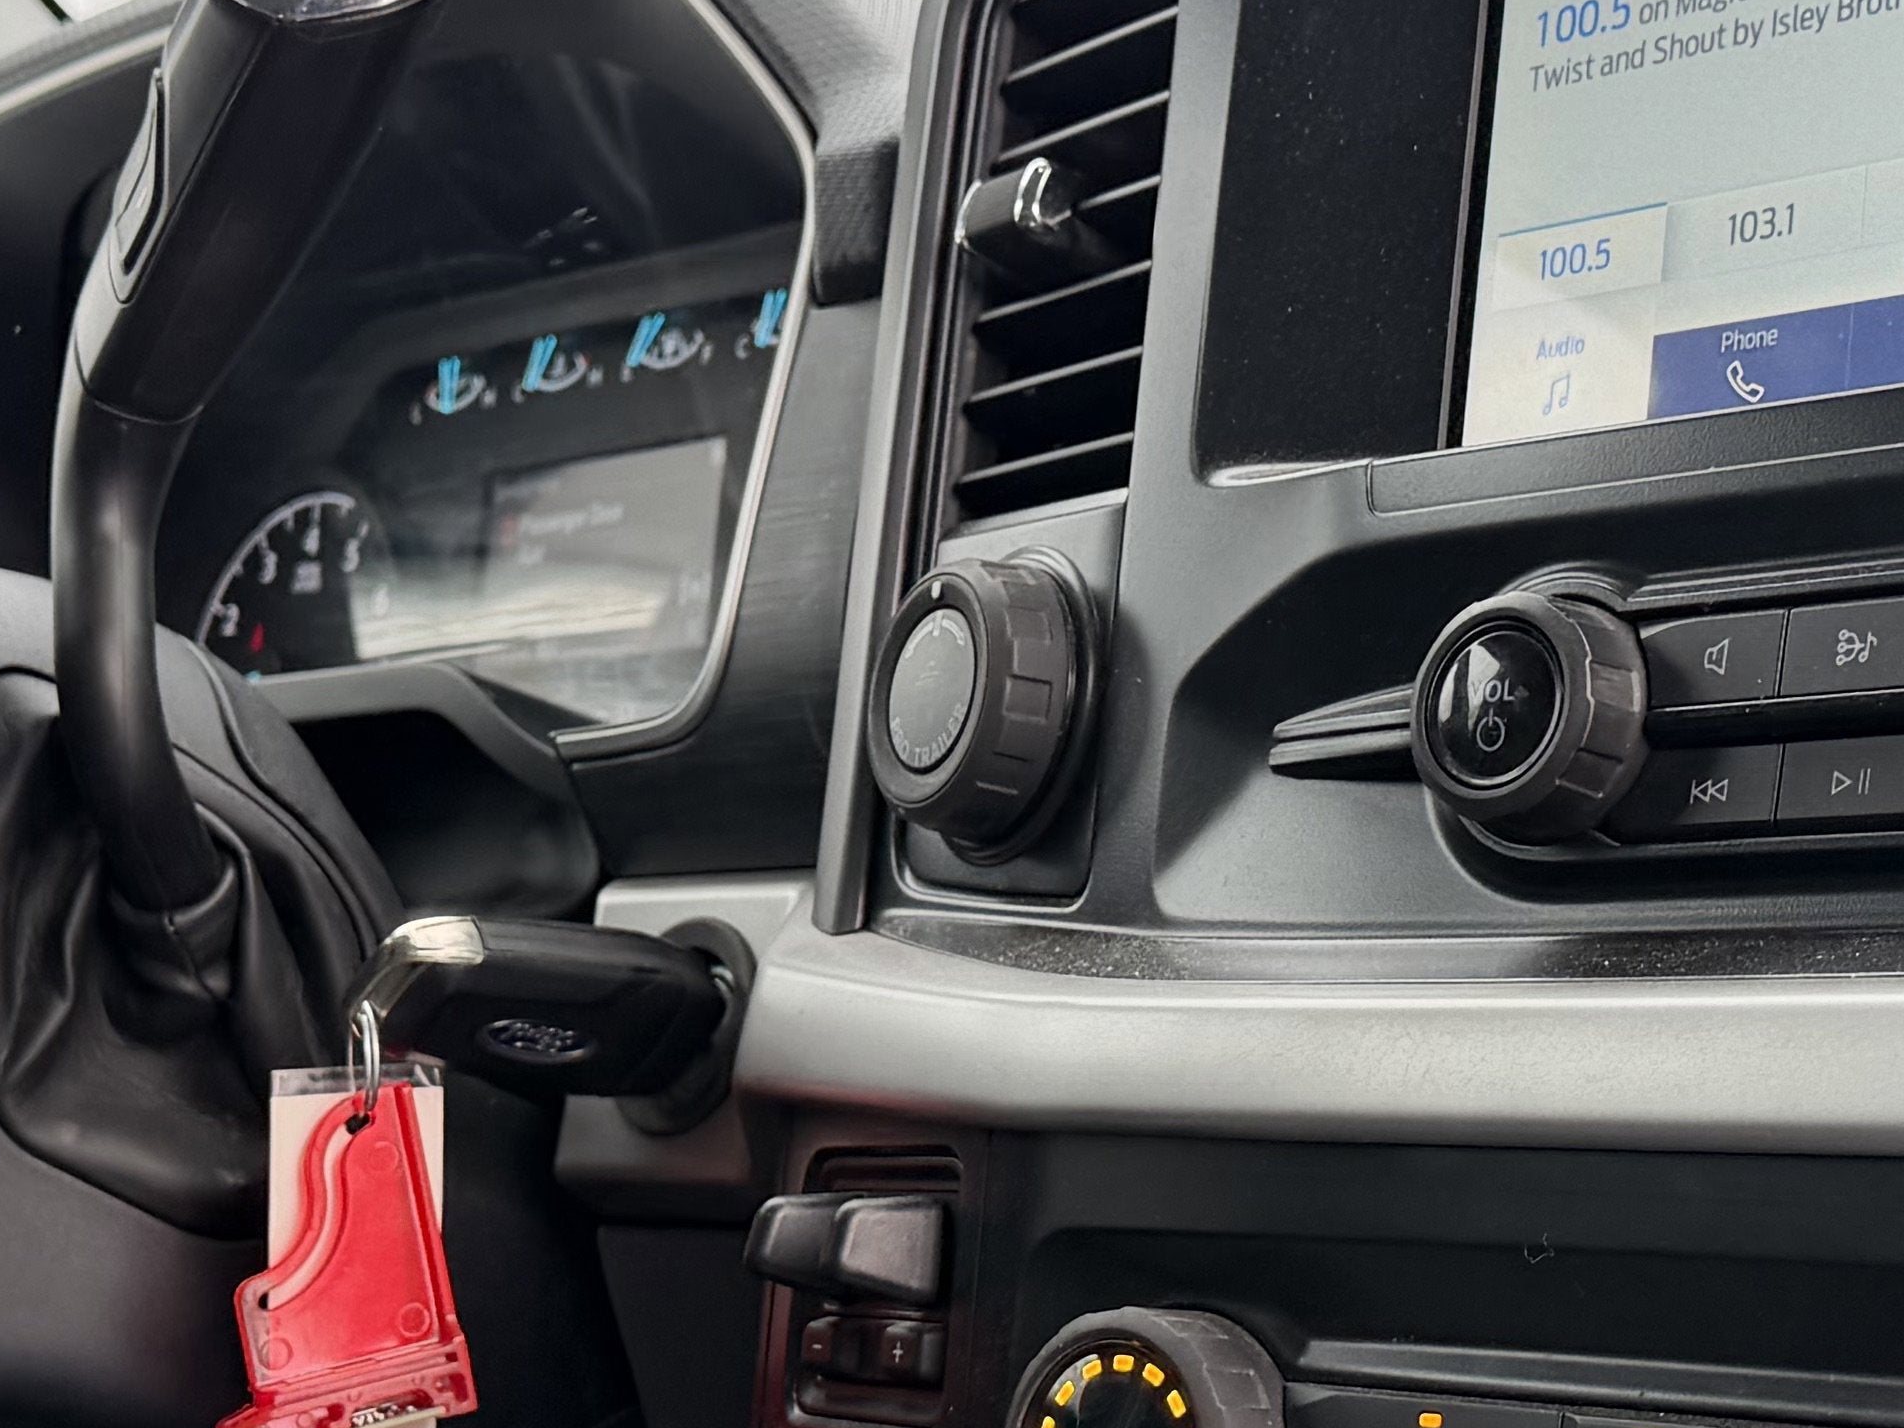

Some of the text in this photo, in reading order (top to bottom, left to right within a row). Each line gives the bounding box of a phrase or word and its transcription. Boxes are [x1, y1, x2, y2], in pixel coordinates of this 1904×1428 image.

[1639, 0, 1668, 24] on
[1530, 52, 1595, 92] Twist
[1600, 39, 1646, 77] and
[1652, 24, 1726, 64] Shout
[1732, 19, 1764, 50] by
[1771, 3, 1829, 38] Isley
[1728, 203, 1797, 246] 103.1
[1539, 239, 1612, 281] 100.5
[1536, 333, 1585, 361] Audio
[1720, 325, 1778, 353] Phone
[1467, 679, 1514, 704] VOL
